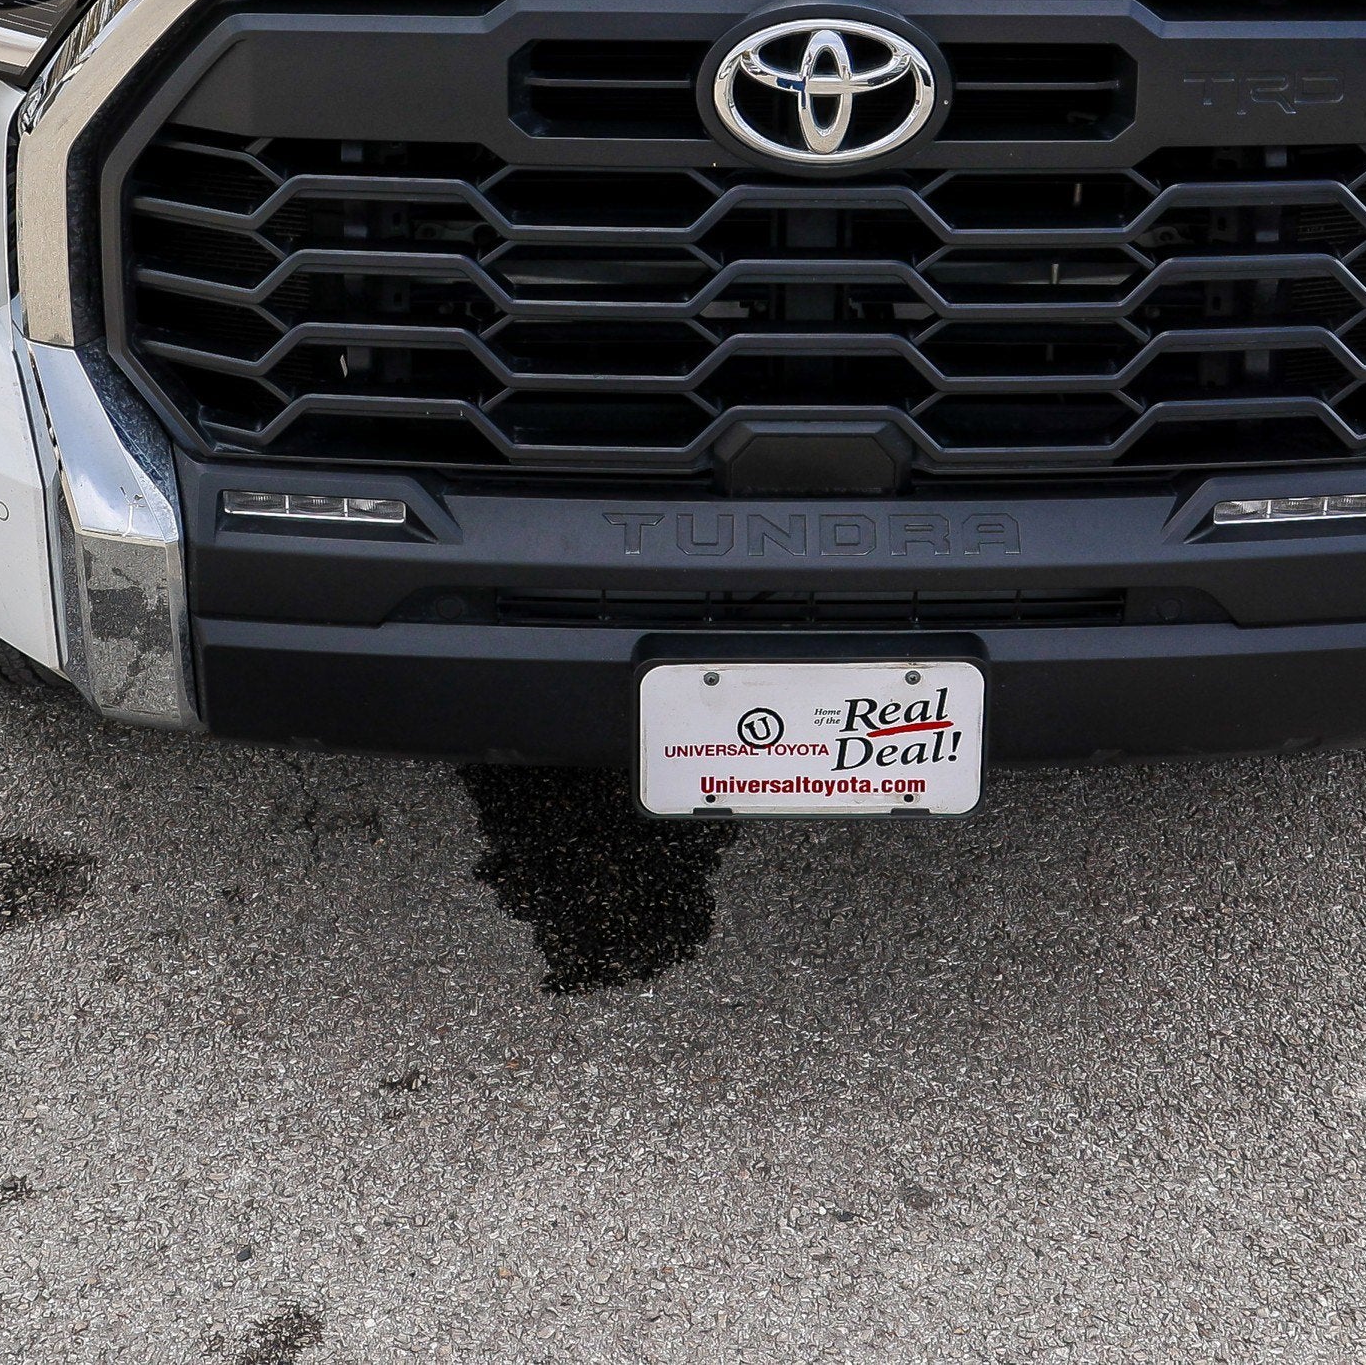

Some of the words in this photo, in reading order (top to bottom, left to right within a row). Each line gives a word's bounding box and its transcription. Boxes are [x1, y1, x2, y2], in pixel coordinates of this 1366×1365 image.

[1184, 69, 1344, 115] TRD
[602, 512, 1022, 556] TUNDRA
[814, 708, 841, 716] Home
[814, 717, 824, 726] of
[839, 687, 948, 732] Real
[664, 744, 760, 758] UNIVERSAL
[765, 743, 830, 756] TOYOTA
[831, 731, 962, 771] Deal!
[700, 776, 926, 797] Universaltoyota.com
